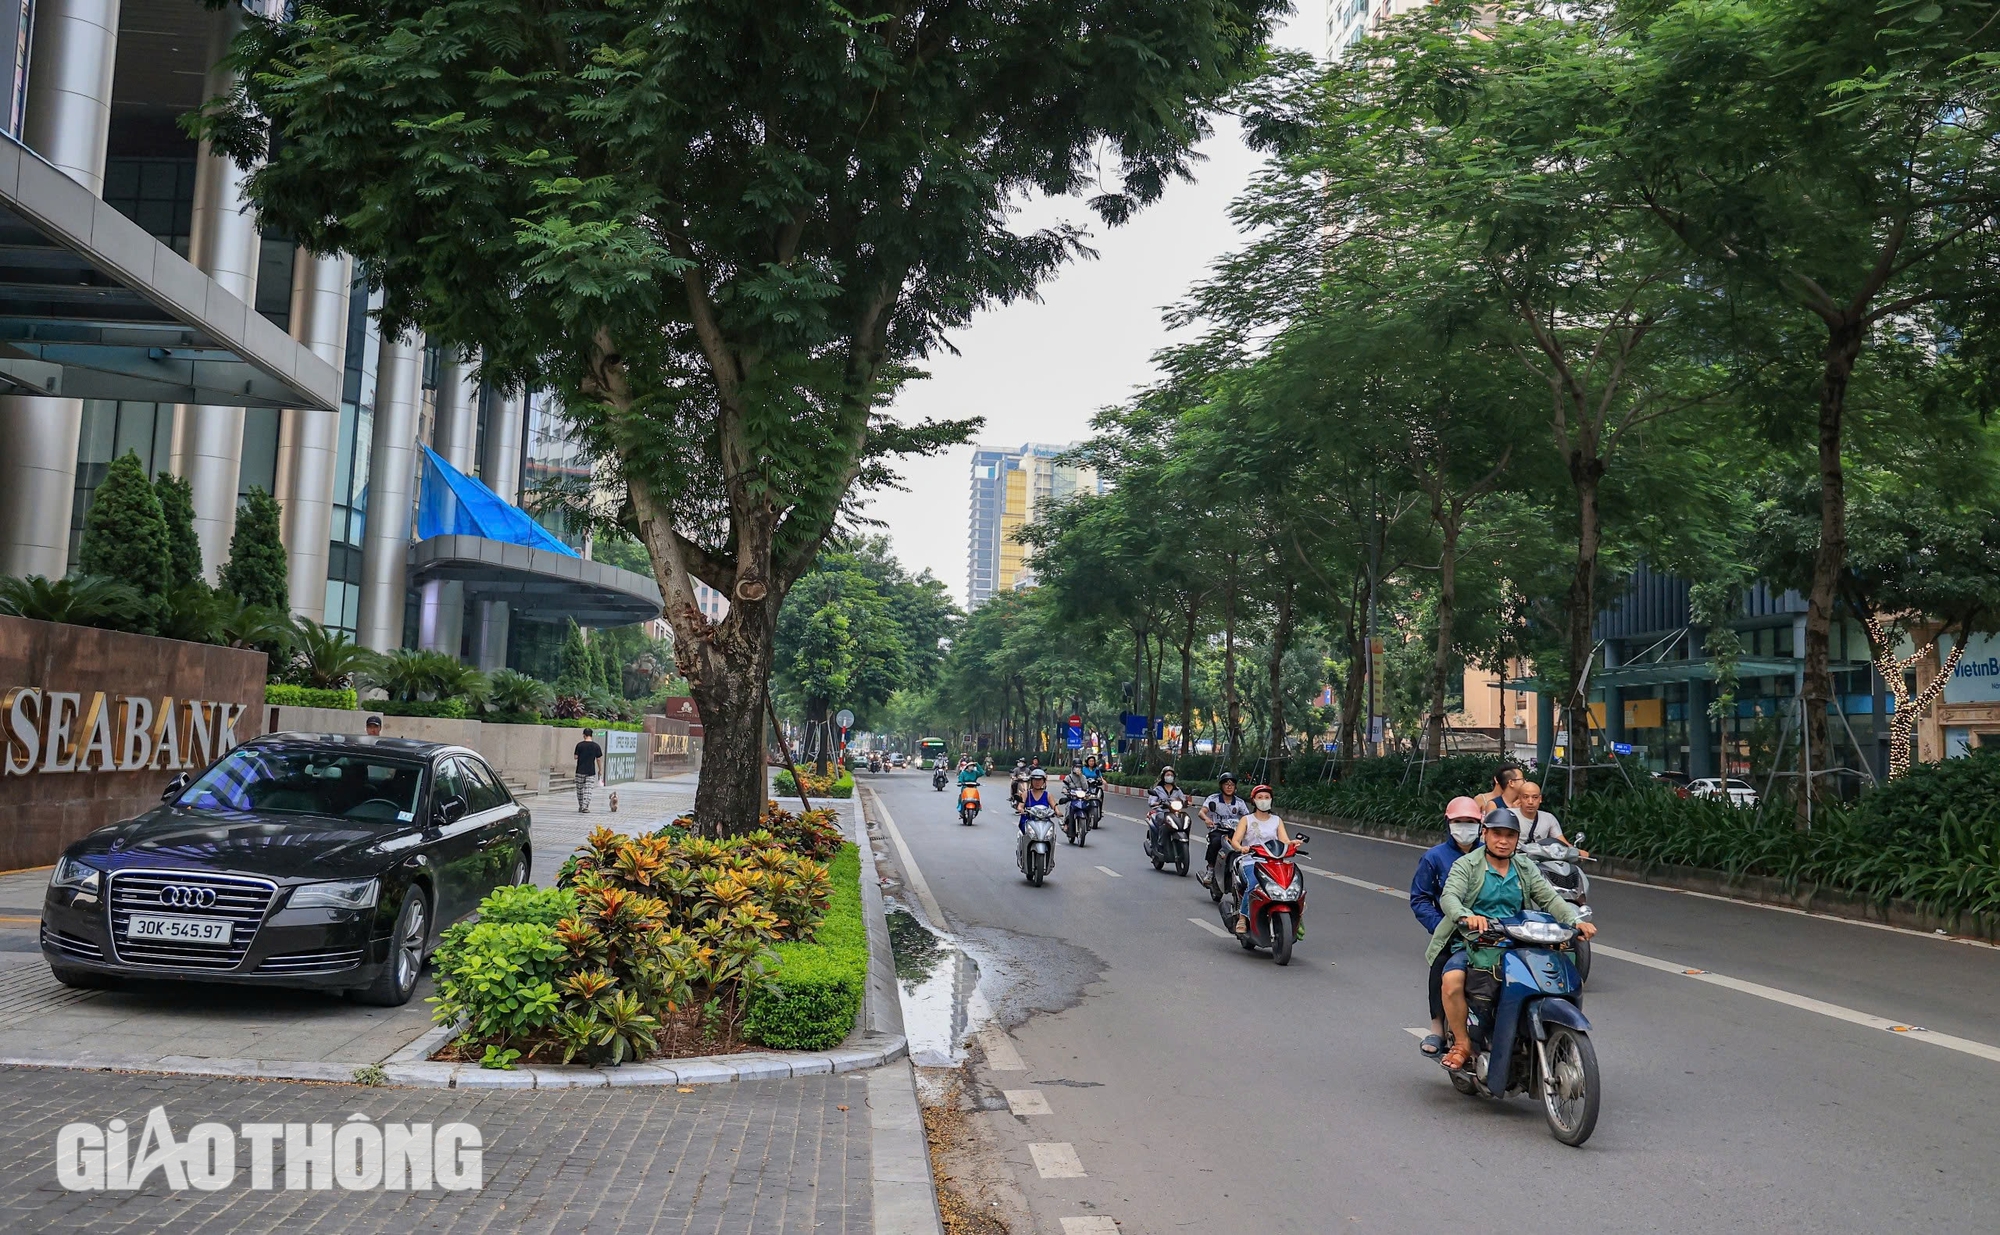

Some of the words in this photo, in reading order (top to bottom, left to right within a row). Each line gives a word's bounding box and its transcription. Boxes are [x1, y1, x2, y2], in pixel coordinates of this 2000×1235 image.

[1953, 657, 2000, 678] VietinB
[3, 687, 247, 776] SEABANK
[137, 920, 223, 939] 30K-545.97
